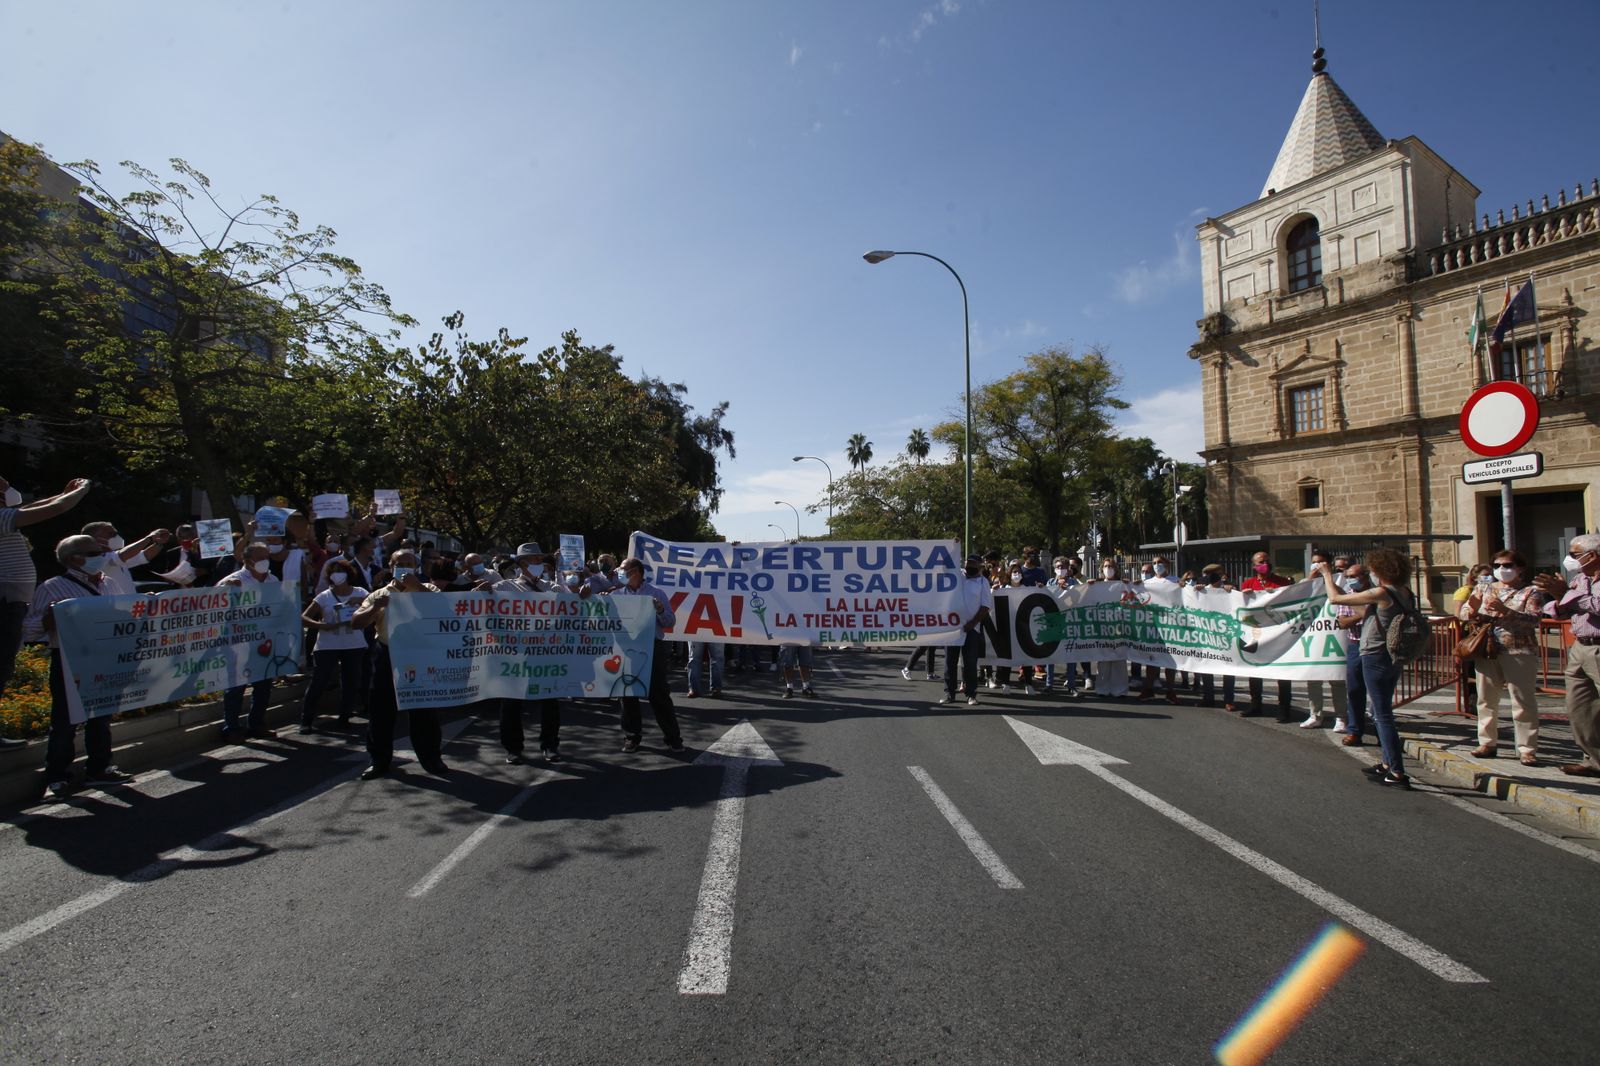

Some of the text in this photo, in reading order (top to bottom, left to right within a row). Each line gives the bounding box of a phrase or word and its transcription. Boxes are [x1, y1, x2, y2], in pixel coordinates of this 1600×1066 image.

[1485, 459, 1512, 469] EXCEPTO
[1501, 464, 1534, 474] OFICIALES
[634, 535, 957, 571] REAPERTURA
[787, 573, 832, 593] DE
[843, 572, 958, 593] SALUD
[826, 598, 909, 612] LA LLAVE
[113, 606, 272, 636] NO AL CIERRE DE URGENCIAS
[439, 617, 622, 632] NO AL CIERRE DE URGENCIAS
[775, 612, 961, 628] LA TIENE EL PUEBLO
[977, 592, 1062, 660] NO
[1065, 608, 1228, 634] AL CIERRE DE URGENCIAS
[1309, 619, 1340, 632] HORA
[135, 636, 157, 650] San
[207, 626, 218, 639] de
[231, 622, 258, 635] Torre
[462, 635, 483, 647] San
[548, 633, 562, 644] de
[564, 633, 575, 644] la
[579, 633, 607, 645] Torre
[819, 630, 918, 643] EL ALMENDRO
[1066, 625, 1081, 638] EN
[1084, 623, 1098, 637] EL
[1135, 625, 1143, 639] Y
[1146, 626, 1230, 650] MATALASCAÑAS
[117, 645, 186, 664] NECESITAMOS
[446, 645, 518, 659] NECESITAMOS
